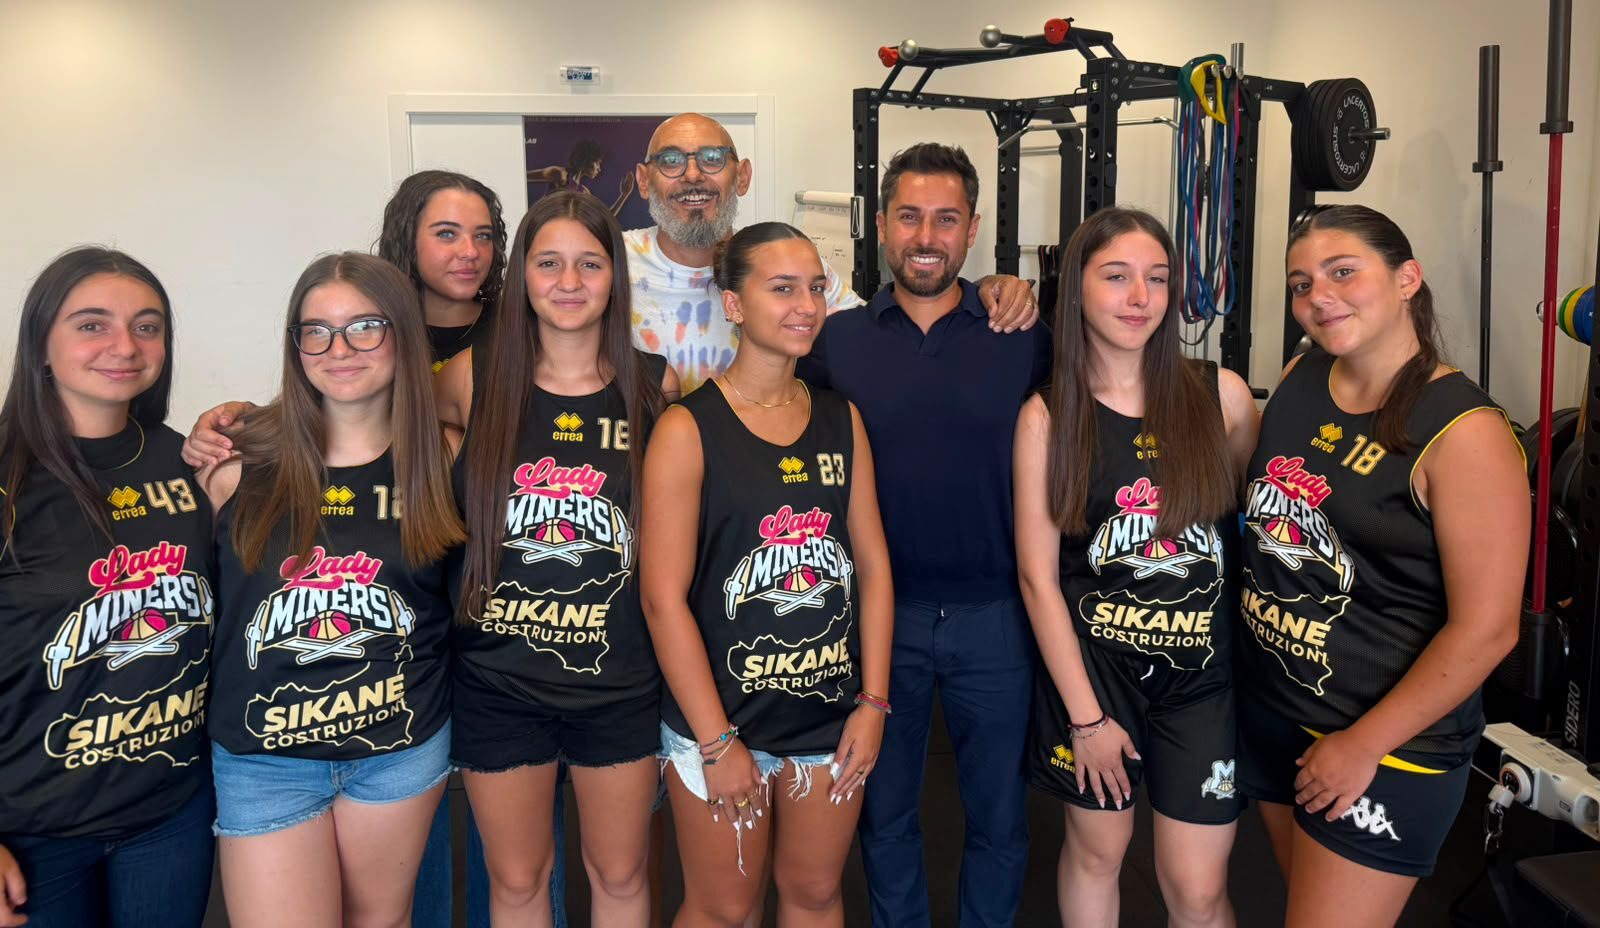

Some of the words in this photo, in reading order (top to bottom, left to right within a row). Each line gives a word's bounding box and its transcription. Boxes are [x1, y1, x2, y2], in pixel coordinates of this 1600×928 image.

[552, 431, 584, 442] errea
[1310, 437, 1335, 454] errea
[1340, 433, 1387, 476] 18
[513, 457, 607, 500] Lady
[782, 472, 808, 484] errea
[817, 452, 845, 486] 23
[1265, 455, 1333, 508] Lady
[111, 505, 147, 521] errea
[143, 478, 198, 515] 43
[320, 505, 354, 516] errea
[505, 494, 612, 544] MINERS
[759, 505, 832, 546] Lady
[1246, 482, 1334, 560] MINERS
[89, 541, 187, 598] Lady
[280, 546, 383, 591] Lady
[747, 537, 839, 594] MINERS
[78, 575, 200, 656] MINERS
[264, 582, 392, 642] MINERS
[483, 598, 611, 629] SIKANE
[1092, 602, 1214, 633] SIKANE
[742, 637, 850, 680] SIKANE
[65, 680, 208, 751] SIKANE
[263, 673, 405, 733] SIKANE
[1564, 679, 1581, 748] SIDERO
